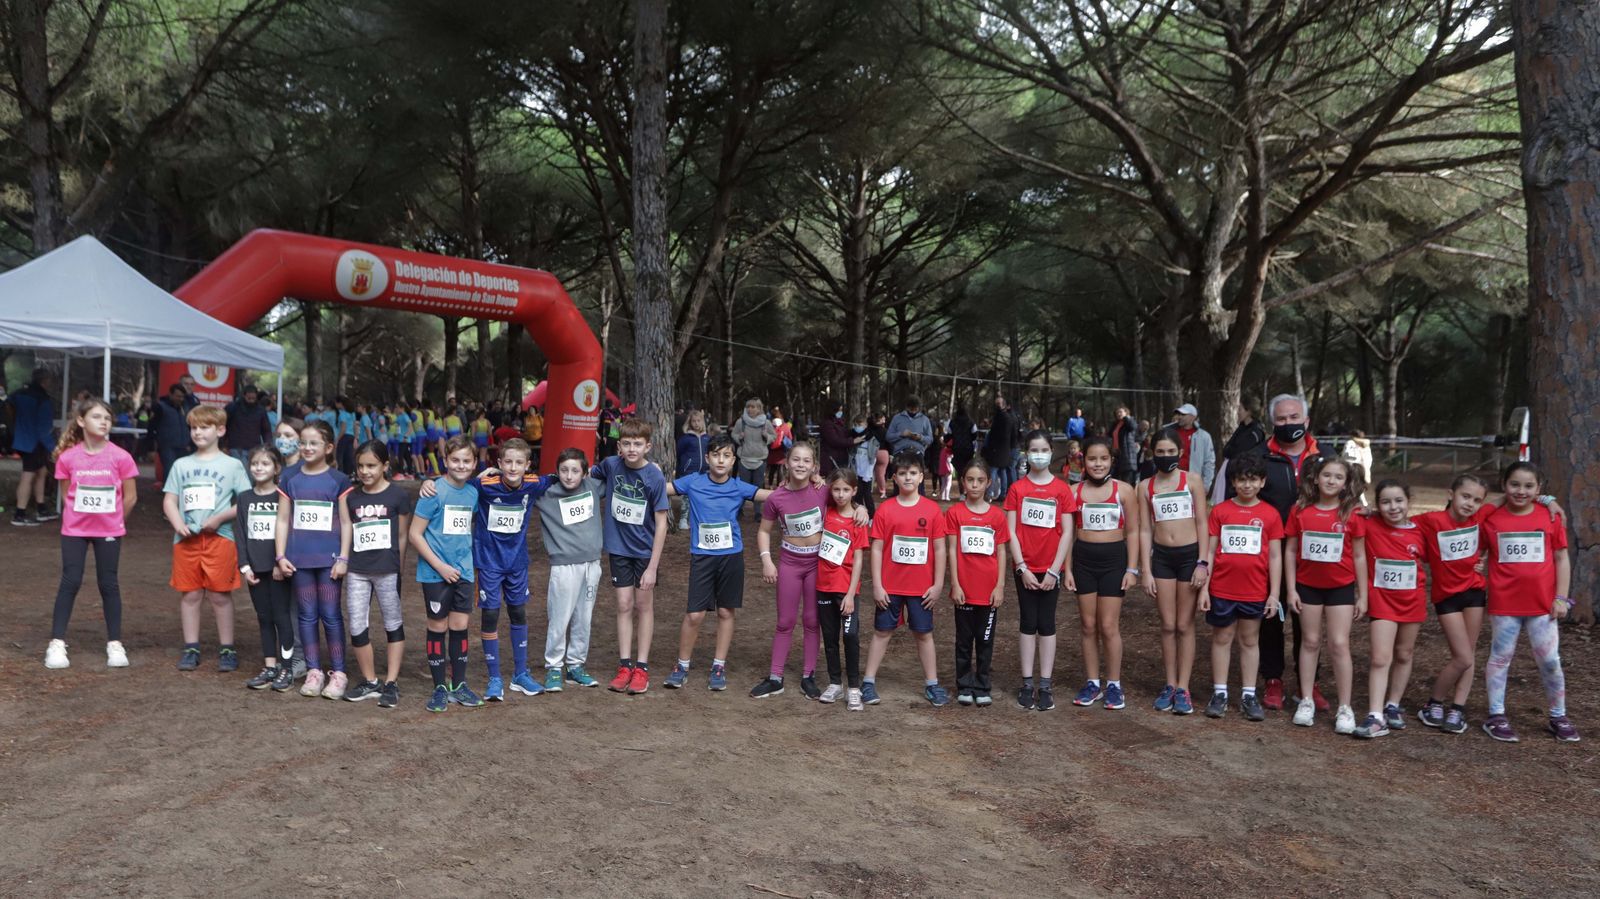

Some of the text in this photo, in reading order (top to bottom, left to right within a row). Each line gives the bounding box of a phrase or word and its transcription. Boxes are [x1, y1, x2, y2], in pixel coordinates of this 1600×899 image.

[395, 260, 519, 293] Delegación de Deportes
[481, 292, 496, 305] San
[82, 496, 102, 506] 632
[356, 504, 384, 518] JOY
[569, 505, 585, 517] 695
[616, 505, 632, 518] 646
[1027, 508, 1044, 520] 660
[1161, 503, 1179, 514] 663
[300, 512, 318, 523] 639
[497, 517, 515, 527] 520
[1089, 513, 1106, 524] 661
[253, 522, 271, 532] 634
[794, 521, 812, 532] 506
[360, 532, 377, 544] 652
[704, 533, 720, 544] 686
[967, 536, 985, 547] 655
[1228, 536, 1247, 547] 659
[1309, 543, 1328, 554] 624
[1450, 540, 1469, 553] 622
[1506, 544, 1528, 555] 668
[899, 547, 916, 558] 693
[1383, 571, 1402, 583] 621
